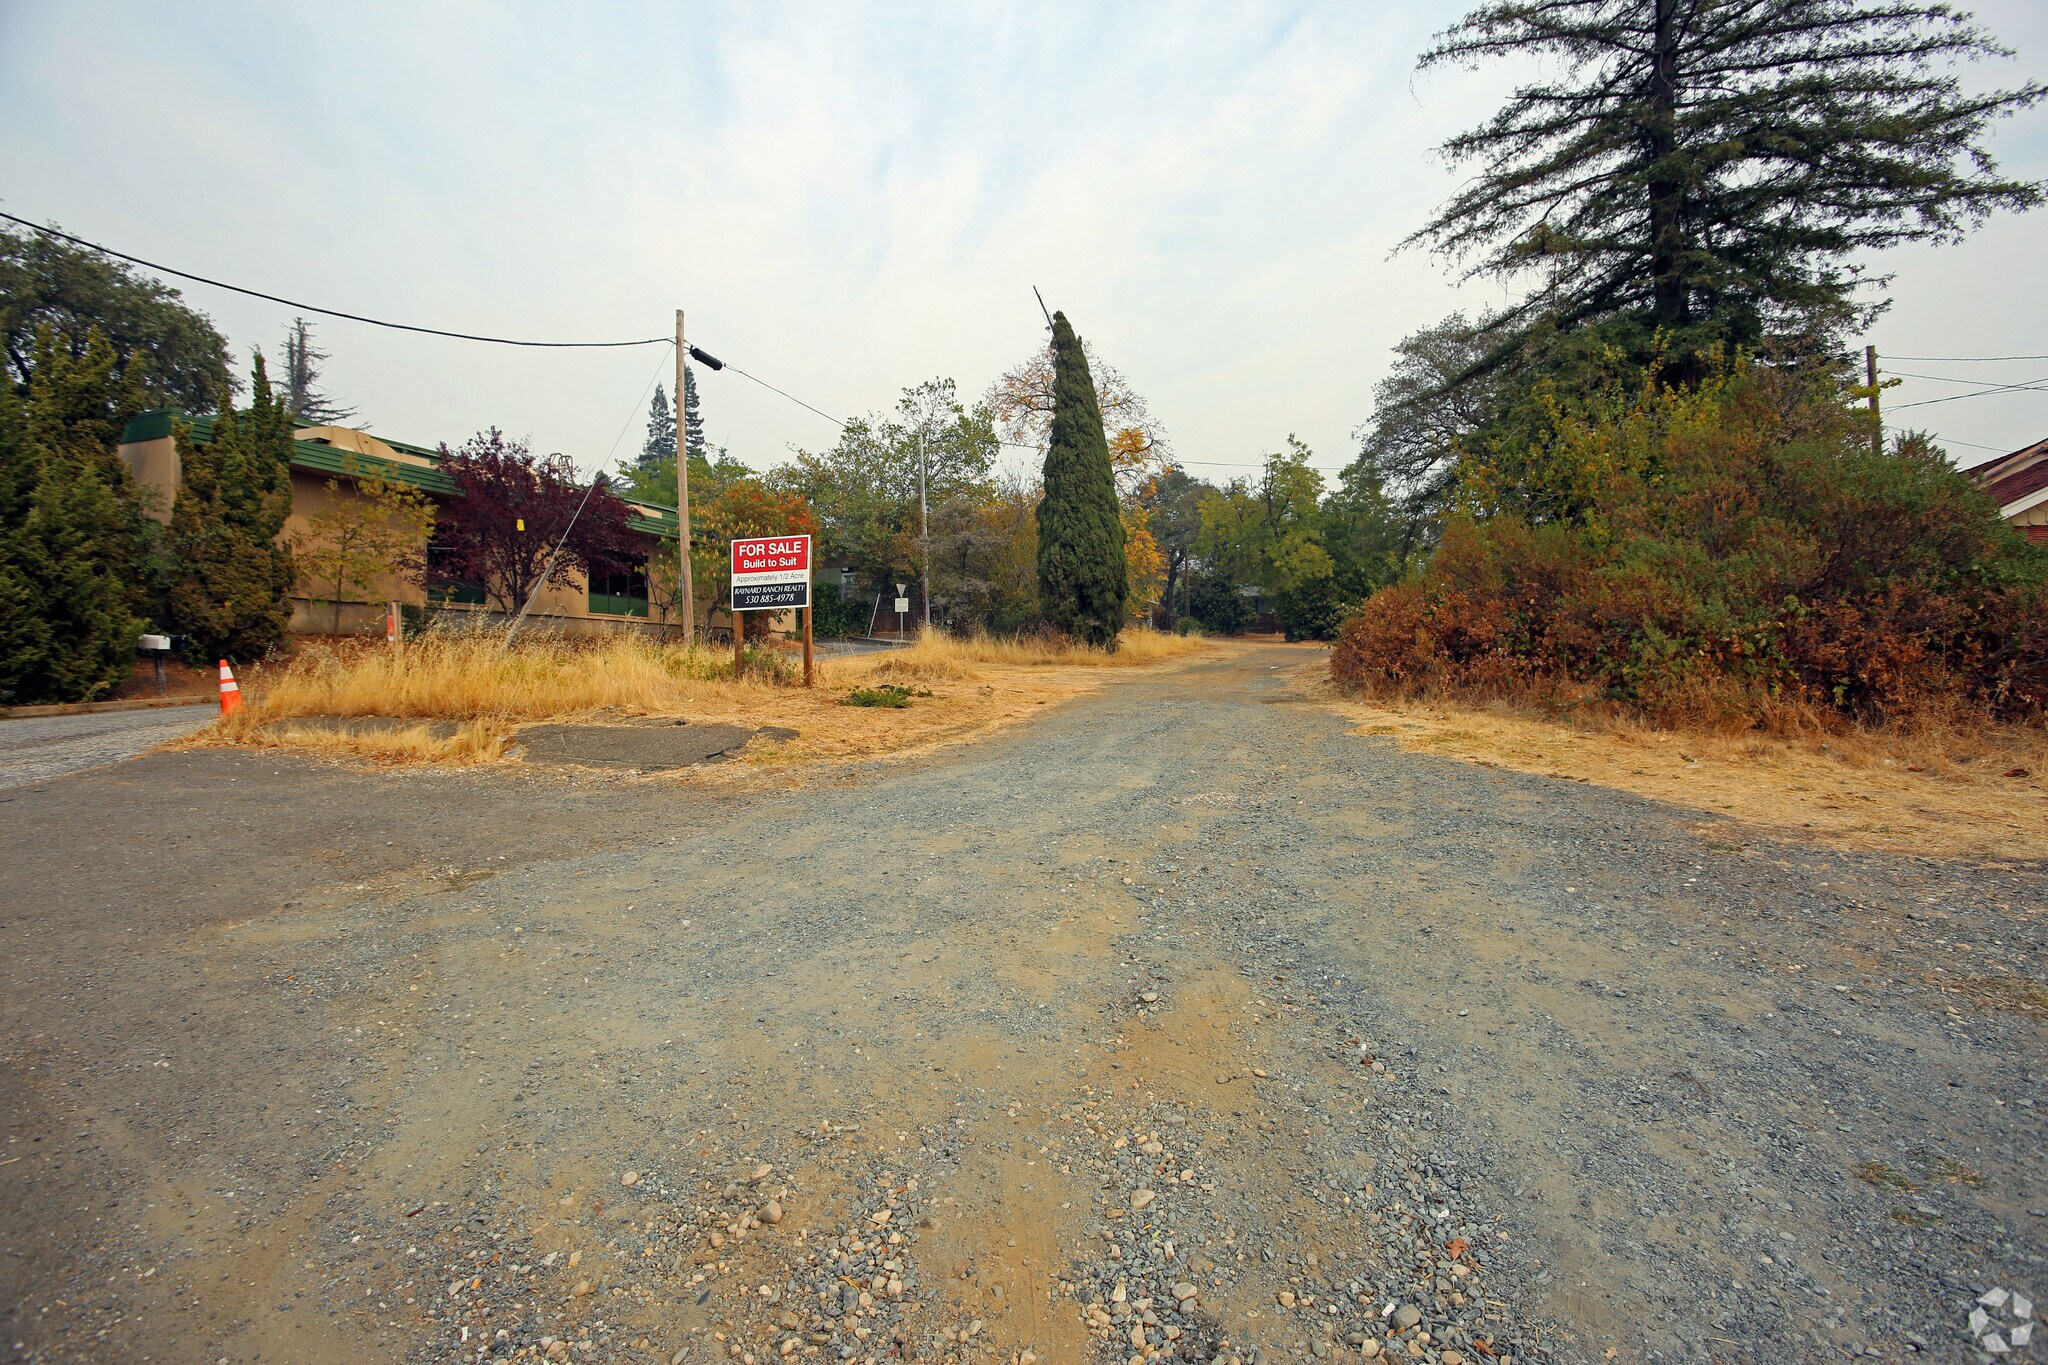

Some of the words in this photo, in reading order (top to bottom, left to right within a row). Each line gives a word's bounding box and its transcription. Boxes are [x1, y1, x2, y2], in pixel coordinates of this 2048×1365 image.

[739, 544, 765, 556] FOR
[768, 541, 802, 554] SALE
[744, 559, 765, 568] Build
[779, 557, 797, 566] Suit
[736, 574, 778, 584] Approximately
[734, 586, 762, 594] RAYNARD
[745, 596, 758, 604] 530
[760, 594, 794, 603] 885-4978
